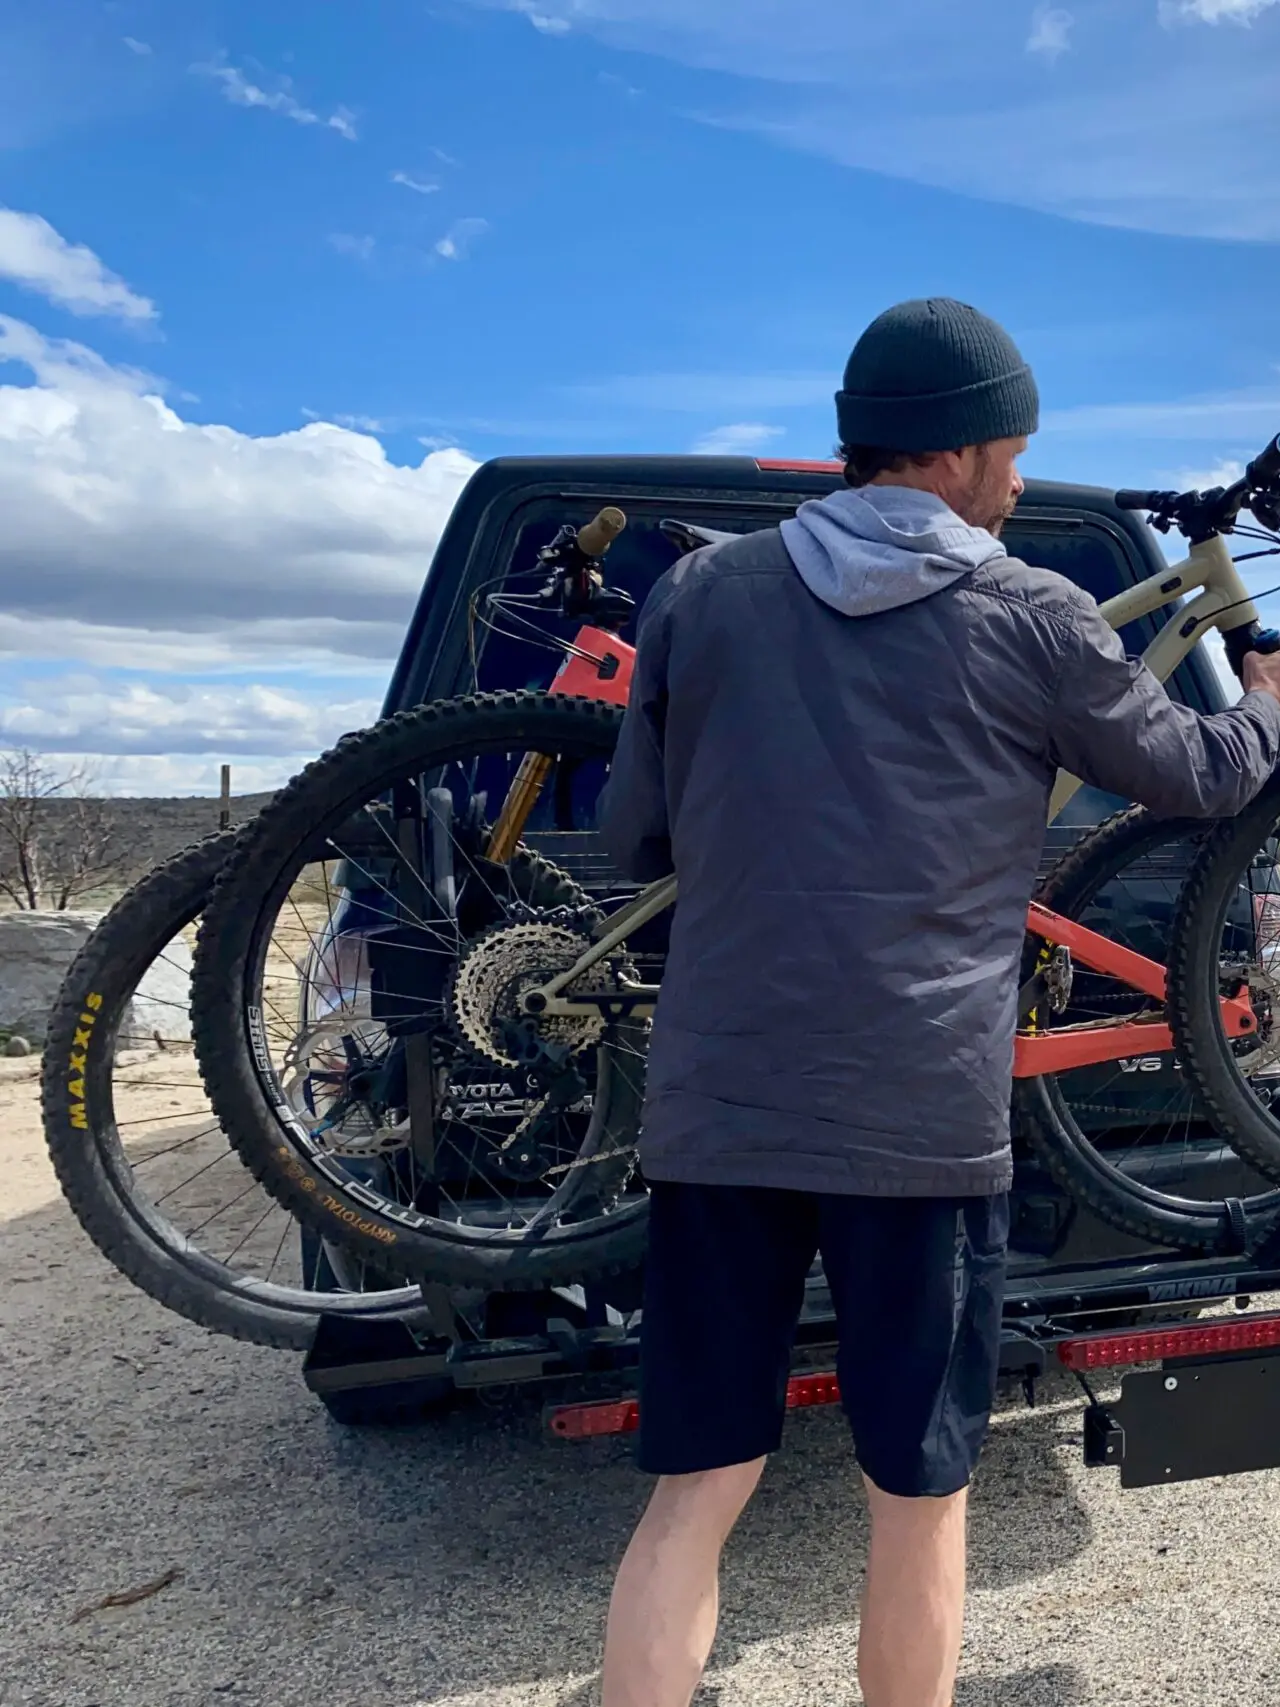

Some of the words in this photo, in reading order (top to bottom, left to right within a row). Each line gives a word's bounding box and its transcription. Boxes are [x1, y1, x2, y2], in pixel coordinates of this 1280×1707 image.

[68, 992, 103, 1129] MAXXIS
[1118, 1057, 1162, 1072] V6
[323, 1195, 397, 1245] KRYPTOTAL
[1147, 1277, 1237, 1301] YAKIMA
